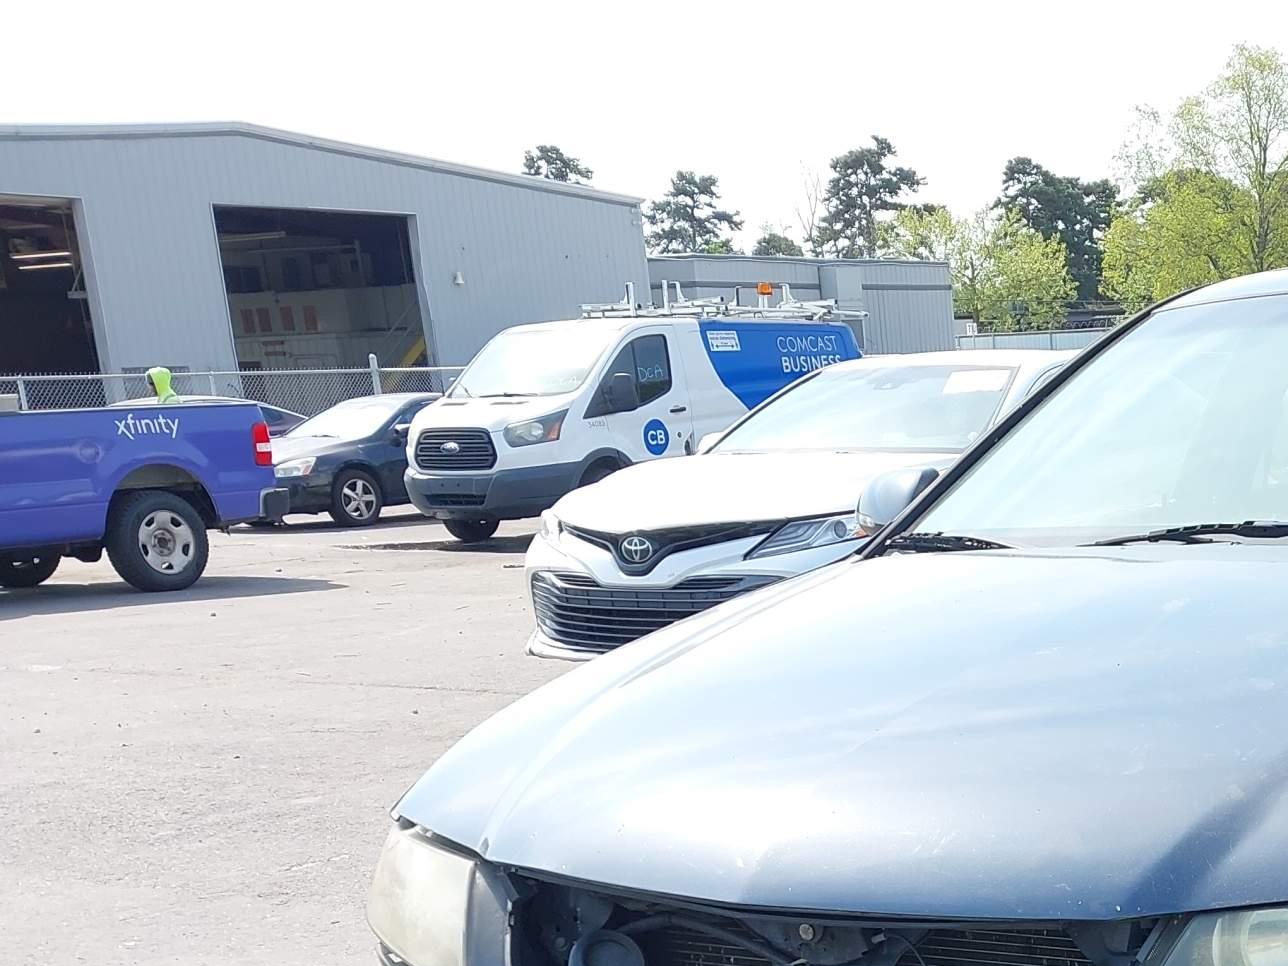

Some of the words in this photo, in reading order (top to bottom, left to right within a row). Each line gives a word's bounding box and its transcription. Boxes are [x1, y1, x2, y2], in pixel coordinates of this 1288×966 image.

[776, 335, 837, 353] COMCAST
[638, 364, 664, 382] DCA
[114, 413, 179, 440] xfinity
[647, 429, 666, 445] CB
